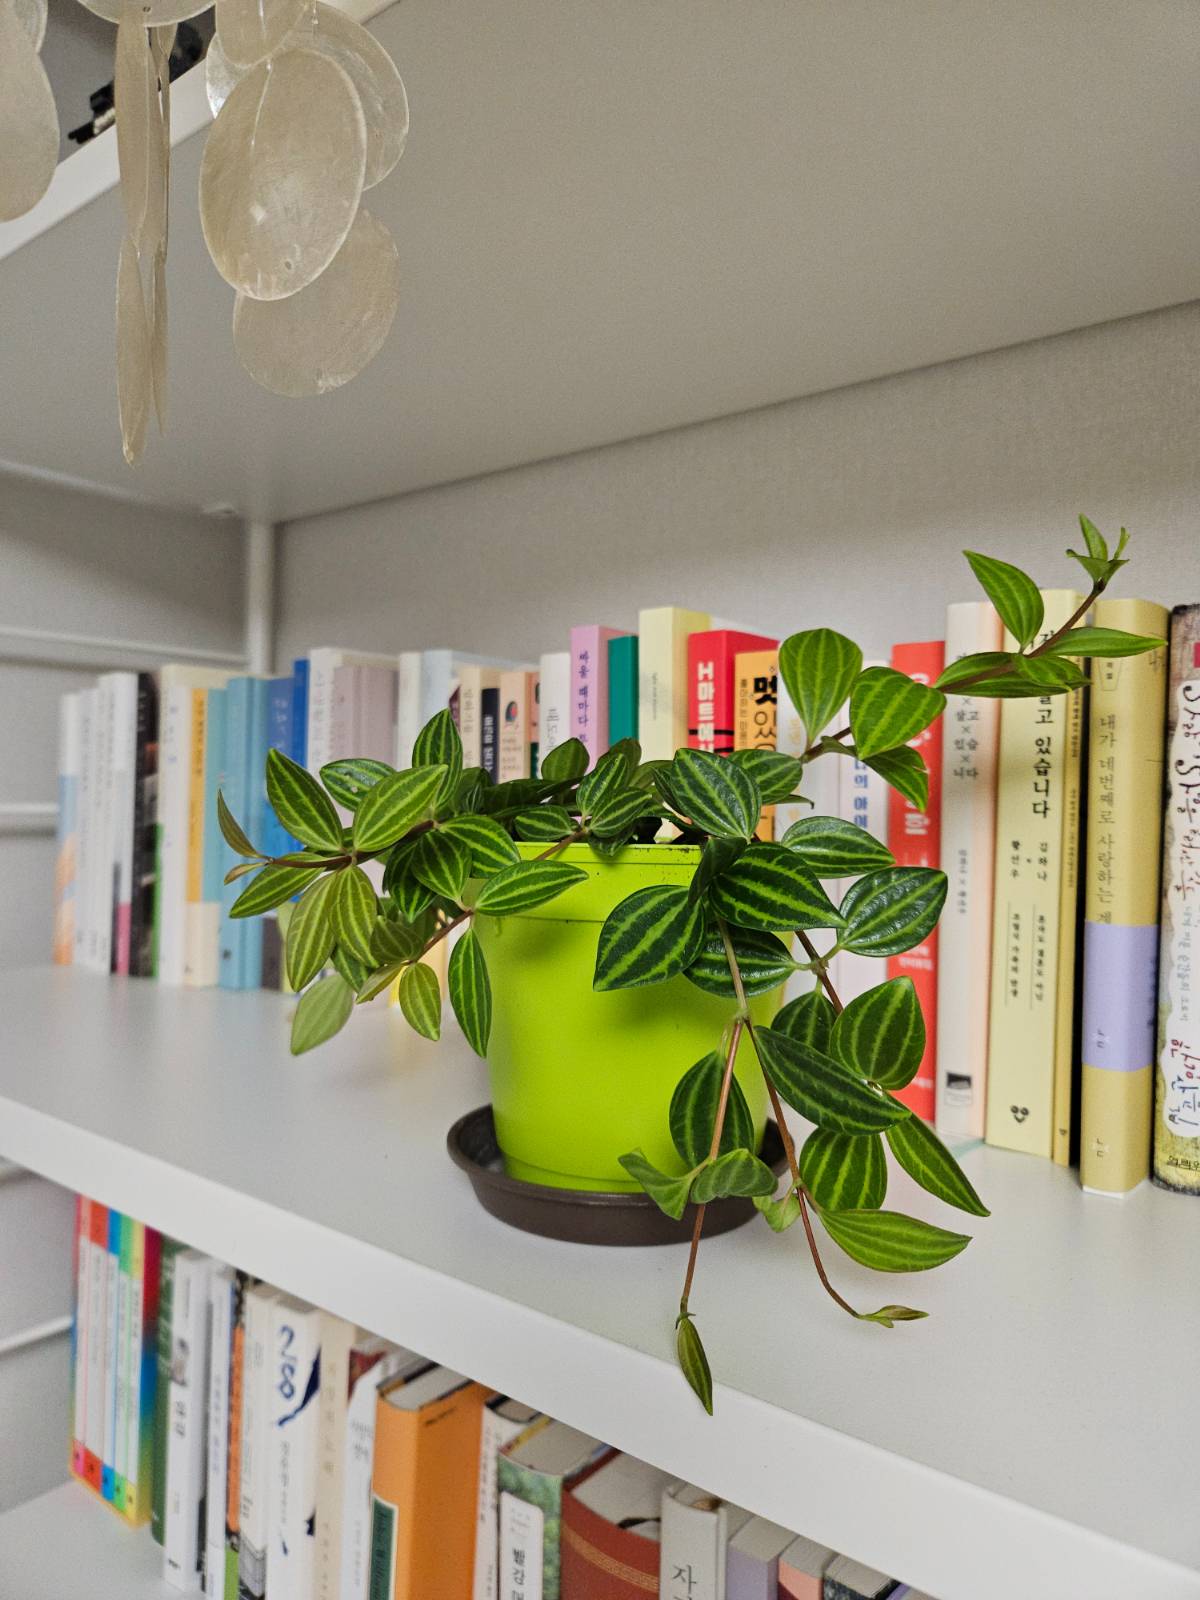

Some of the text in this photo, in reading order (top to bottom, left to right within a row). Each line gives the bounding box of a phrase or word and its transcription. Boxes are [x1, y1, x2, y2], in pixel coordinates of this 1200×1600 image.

[577, 686, 589, 727] 때마다
[1099, 714, 1117, 748] 내가
[1032, 736, 1052, 819] 있습니다
[1096, 833, 1116, 904] 사랑하는
